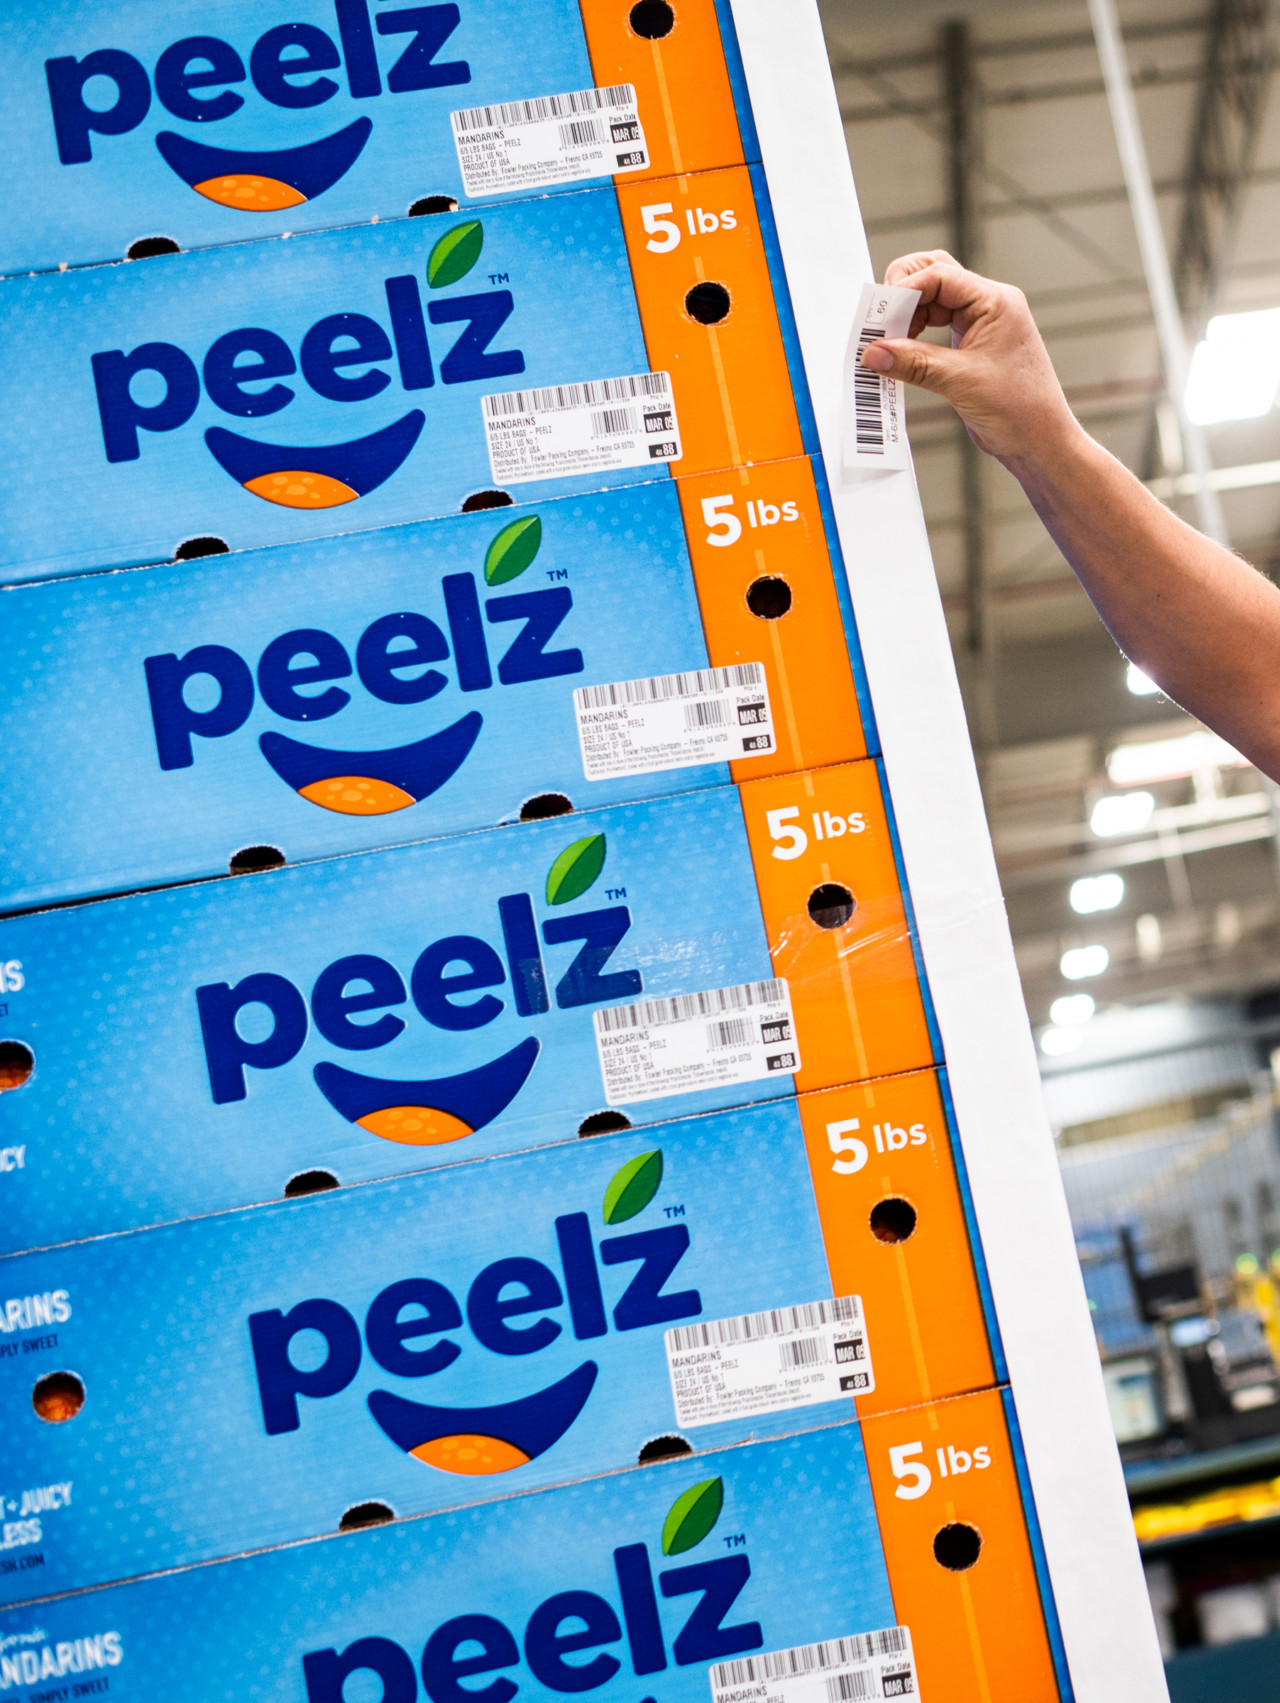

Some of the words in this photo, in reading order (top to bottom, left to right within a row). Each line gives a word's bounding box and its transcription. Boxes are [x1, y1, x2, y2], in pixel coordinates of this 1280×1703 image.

[44, 0, 472, 165] peelz
[609, 115, 621, 123] Pack
[458, 130, 505, 145] MANDARINS
[613, 127, 630, 141] MAR
[470, 145, 480, 153] LBS
[482, 143, 496, 151] BAGS
[504, 138, 521, 147] PEELZ
[462, 155, 474, 164] SIZE
[464, 161, 489, 172] PRODUCT
[499, 158, 510, 166] USA
[630, 152, 642, 164] 88
[640, 202, 681, 254] 5
[685, 207, 738, 235] lbs
[877, 300, 888, 315] 60
[91, 274, 526, 464] peelz
[643, 404, 656, 412] Pack
[659, 402, 671, 410] Date
[489, 416, 536, 431] MANDARINS
[647, 417, 664, 432] MAR
[500, 431, 510, 439] LBS
[512, 429, 527, 438] BAGS
[535, 426, 552, 434] PEELZ
[492, 442, 504, 450] SIZE
[493, 449, 519, 459] PRODUCT
[520, 447, 527, 455] OF
[529, 446, 540, 454] USA
[664, 444, 675, 456] 88
[700, 494, 742, 547] 5
[746, 499, 799, 528] lbs
[143, 572, 584, 771] peelz
[737, 696, 749, 704] Pack
[580, 709, 628, 724] MANDARINS
[740, 709, 757, 724] MAR
[585, 742, 611, 753] PRODUCT
[757, 736, 768, 748] 88
[766, 805, 808, 861] 5
[812, 810, 866, 841] lbs
[195, 892, 643, 1105] peelz
[601, 1030, 650, 1048] MANDARINS
[826, 1117, 869, 1175] 5
[873, 1122, 927, 1153] lbs
[248, 1211, 702, 1436] peelz
[23, 1333, 58, 1354] SWEET
[671, 1350, 721, 1368] MANDARINS
[888, 1441, 932, 1500] 5
[936, 1445, 991, 1477] lbs
[302, 1542, 764, 1703] peelz
[881, 1664, 894, 1674] Pack
[71, 1677, 110, 1700] SWEET
[717, 1685, 768, 1703] MANDARINS
[884, 1678, 902, 1695] MAR
